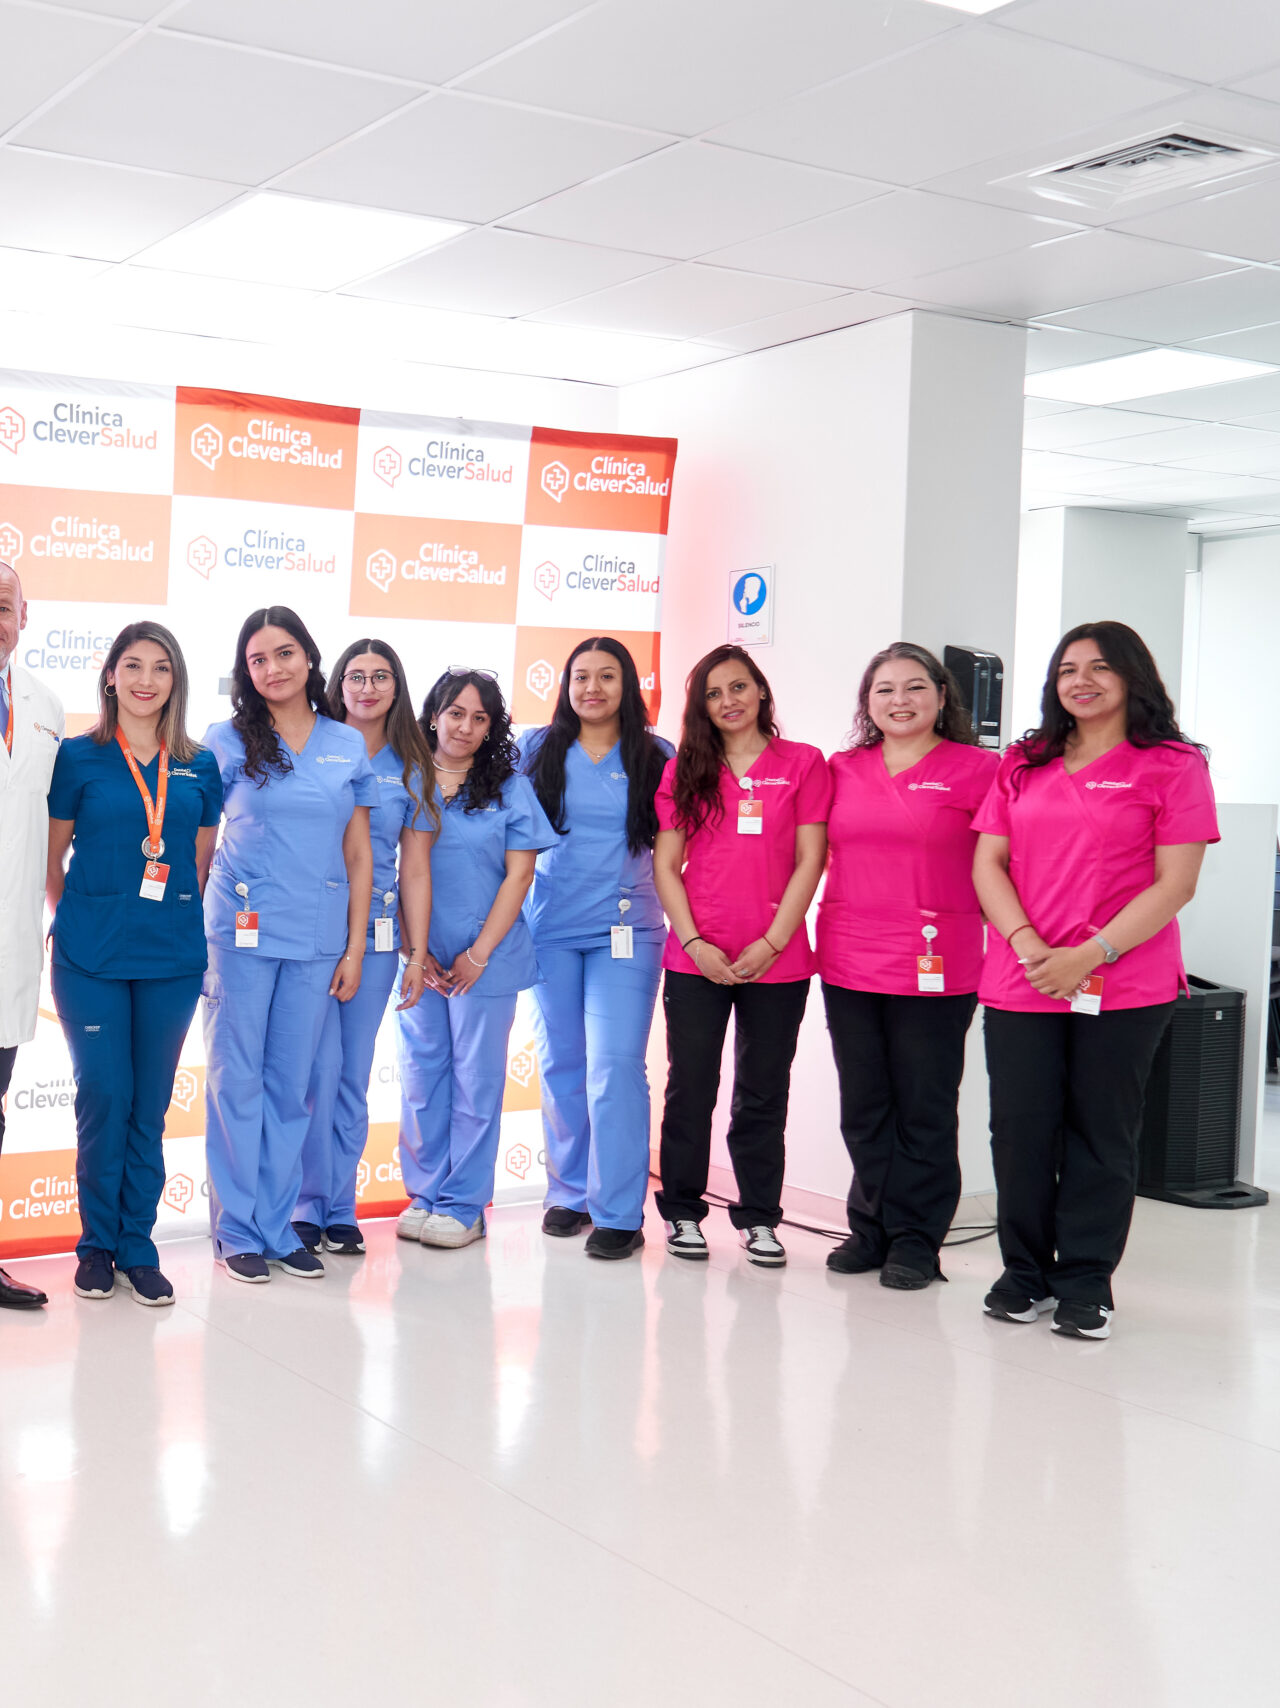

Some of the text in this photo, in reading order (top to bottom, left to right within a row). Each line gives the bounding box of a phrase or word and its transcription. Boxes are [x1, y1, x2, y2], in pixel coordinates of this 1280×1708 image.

[52, 402, 123, 426] Clínica
[32, 422, 157, 450] CleverSalud
[246, 420, 312, 446] Clínica
[228, 437, 342, 468] CleverSalud
[426, 441, 484, 462] Clínica
[408, 458, 512, 483] CleverSalud
[591, 456, 645, 476] Clínica
[573, 472, 668, 496] CleverSalud
[50, 516, 120, 540] Clínica
[30, 536, 153, 561] CleverSalud
[243, 530, 305, 552] Clínica
[419, 542, 478, 564] Clínica
[224, 547, 335, 572] CleverSalud
[582, 554, 635, 574] Clínica
[401, 560, 506, 585] CleverSalud
[566, 572, 660, 594] CleverSalud
[25, 648, 104, 670] CleverS
